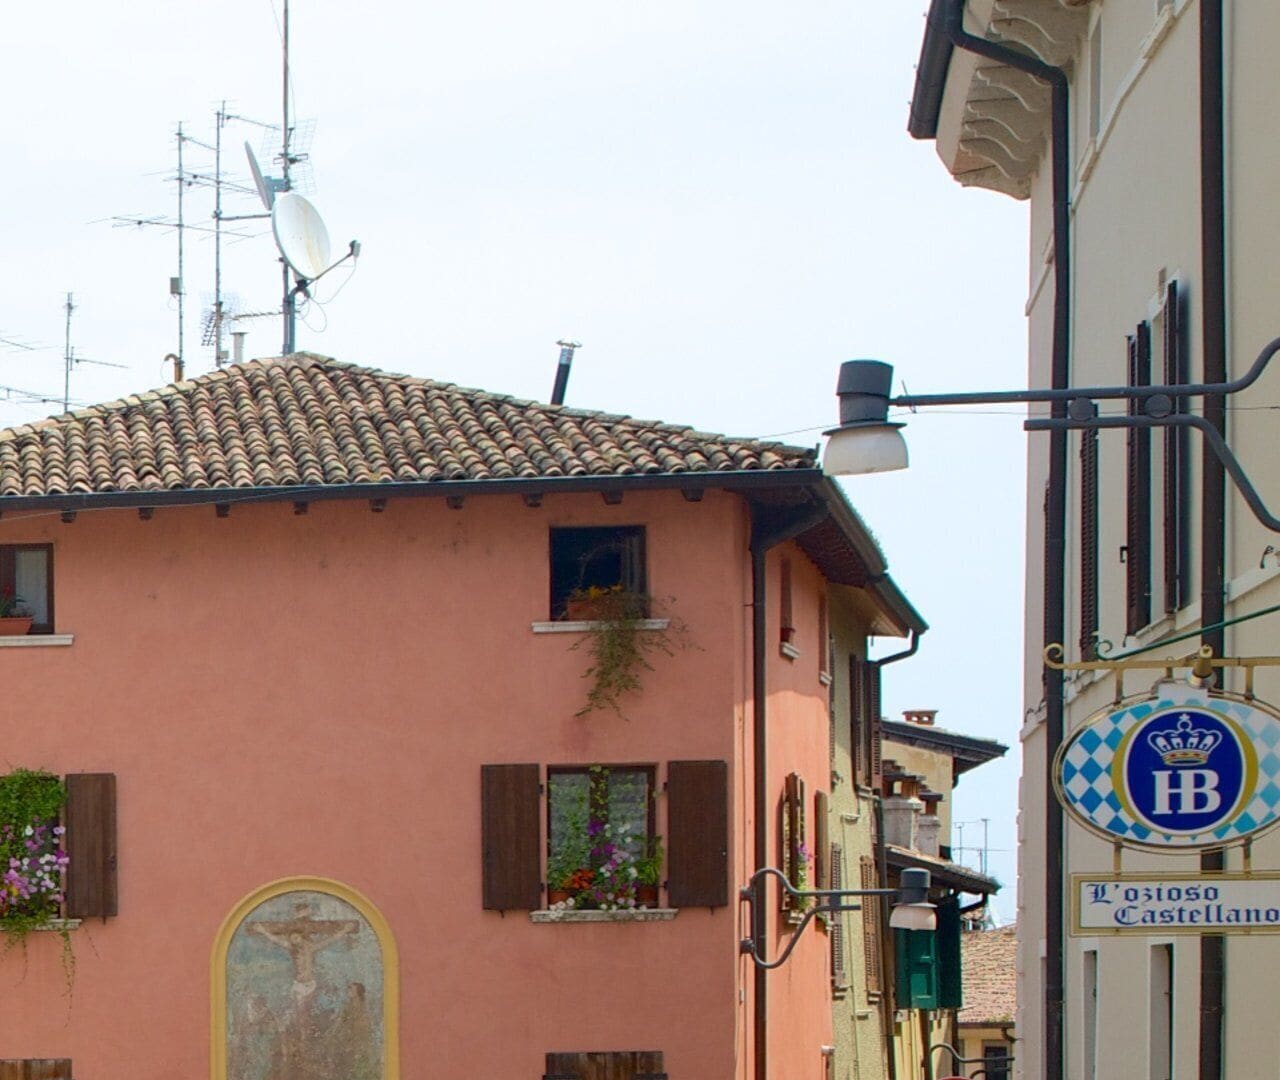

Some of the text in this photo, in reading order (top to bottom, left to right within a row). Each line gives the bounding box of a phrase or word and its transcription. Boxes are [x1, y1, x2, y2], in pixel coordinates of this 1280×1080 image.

[1152, 769, 1221, 814] HB
[1086, 883, 1219, 905] L'ozioso
[1114, 904, 1280, 925] Castellano
